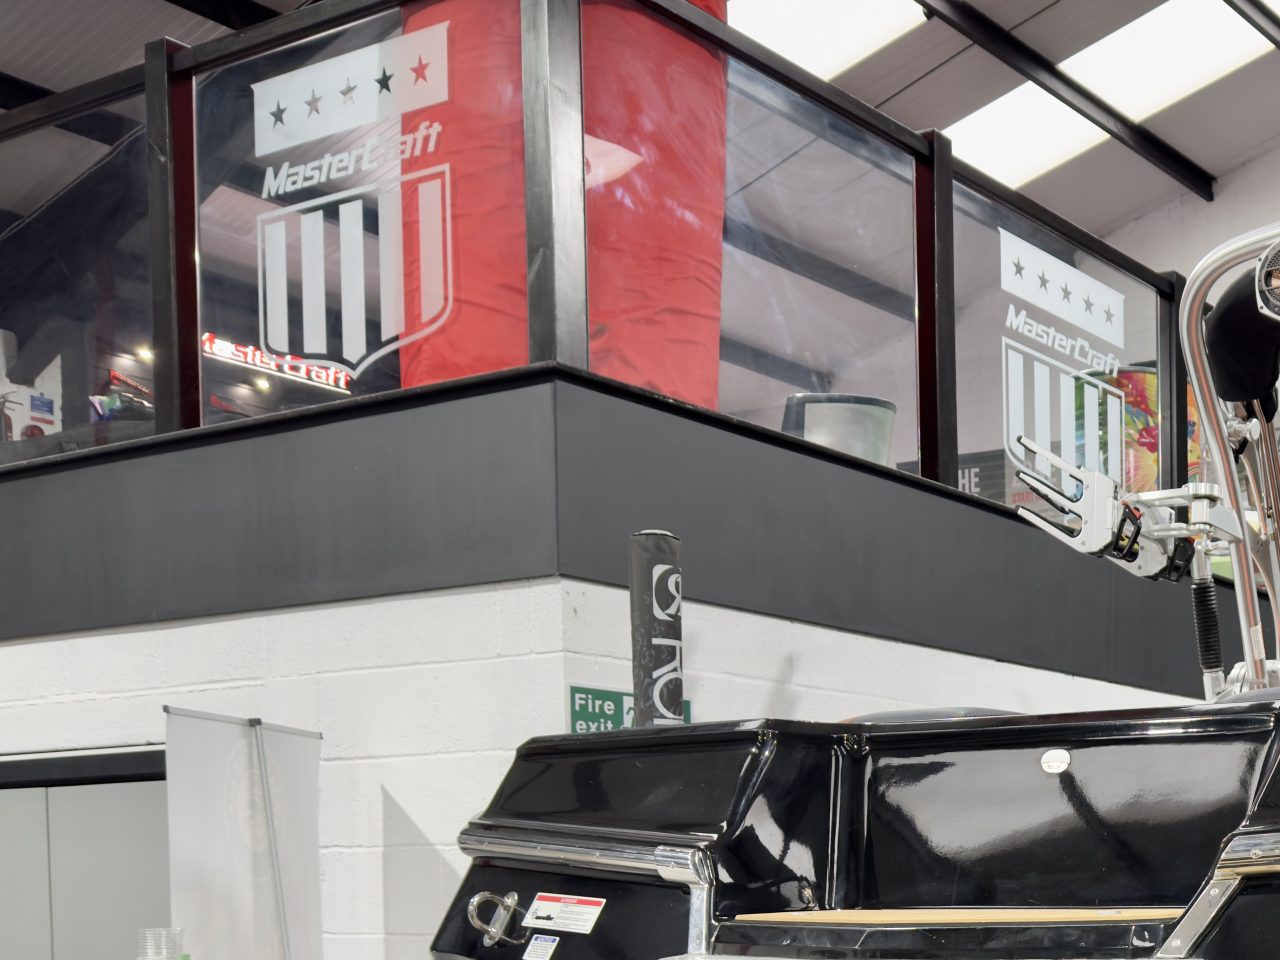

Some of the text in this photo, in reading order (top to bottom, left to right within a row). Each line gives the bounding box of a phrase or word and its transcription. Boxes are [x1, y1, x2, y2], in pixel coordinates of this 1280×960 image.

[1006, 304, 1121, 377] MasterCraft
[574, 693, 615, 714] Fire
[575, 719, 613, 734] exit
